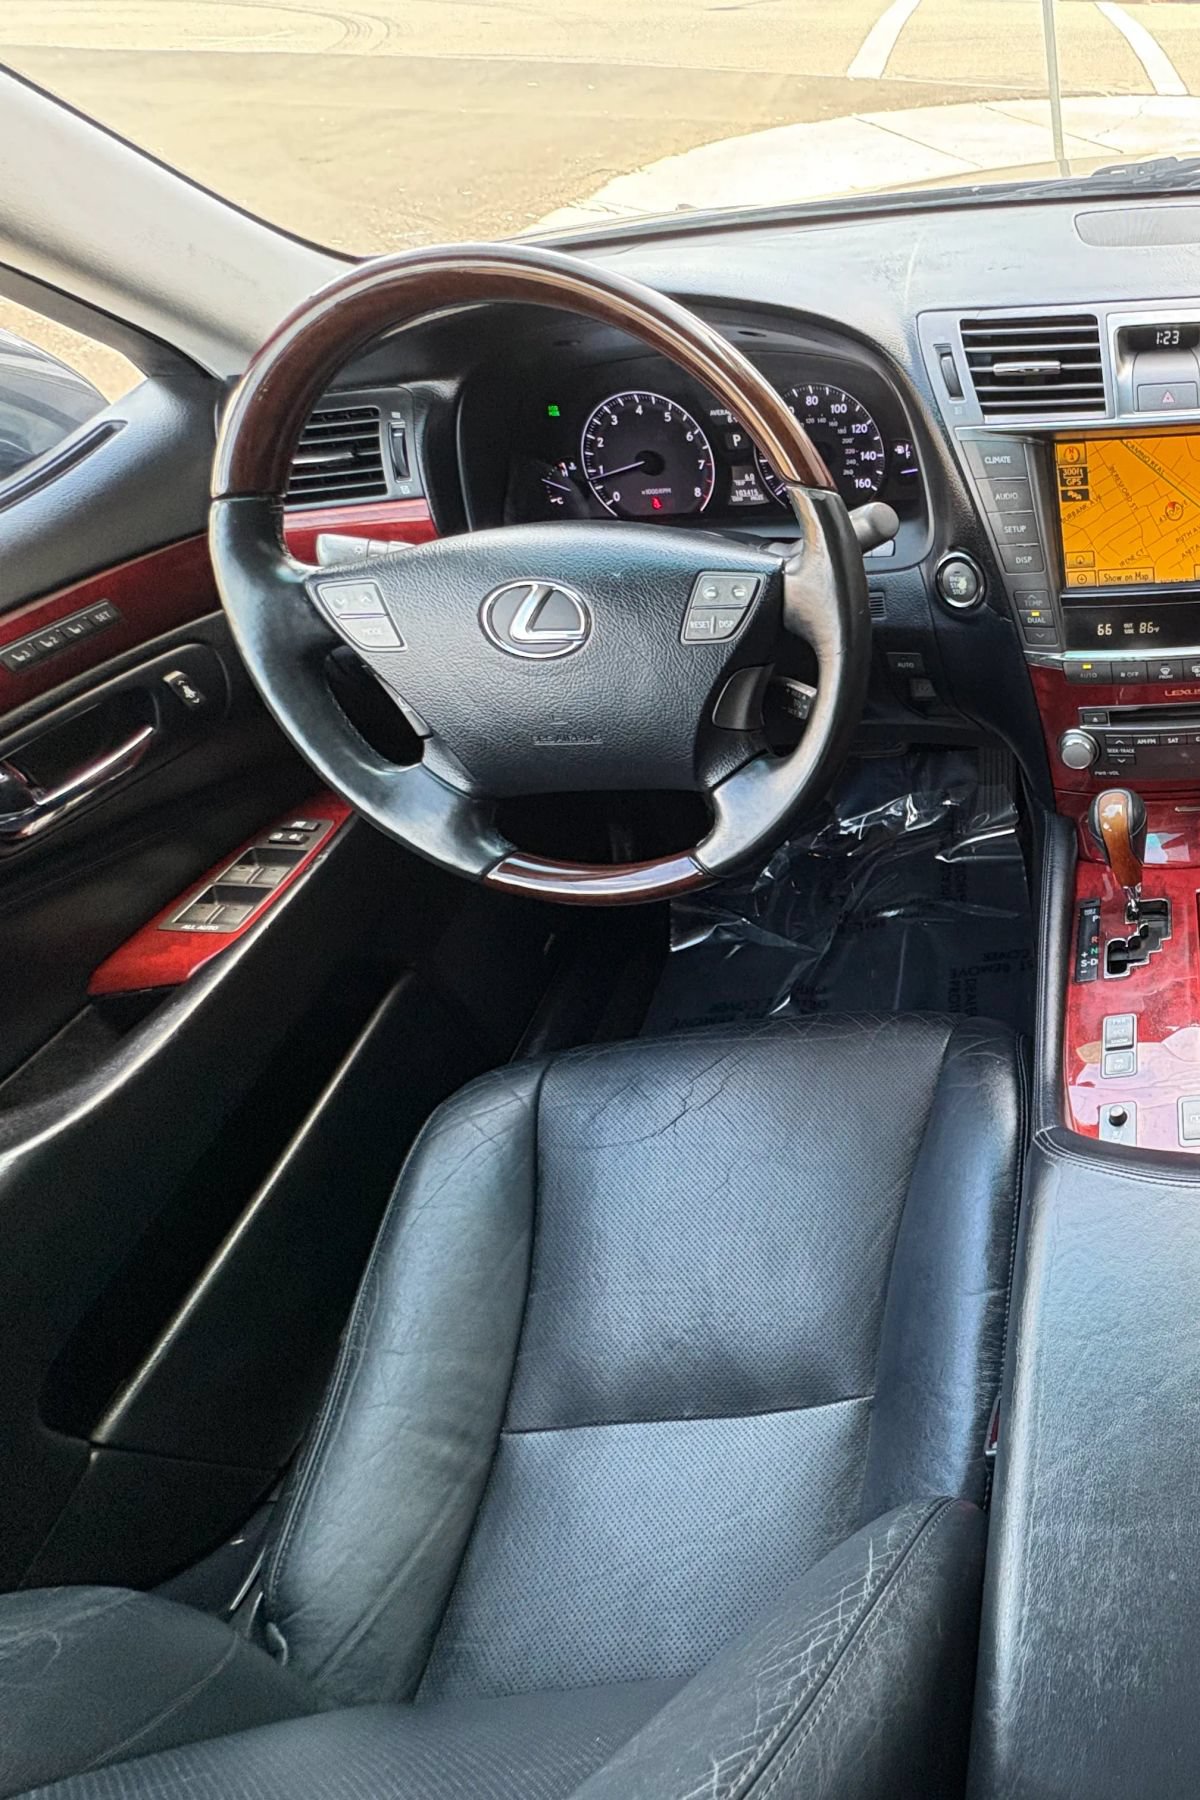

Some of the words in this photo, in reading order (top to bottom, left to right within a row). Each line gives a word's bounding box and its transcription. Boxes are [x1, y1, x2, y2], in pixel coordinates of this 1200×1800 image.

[1156, 330, 1179, 345] 1:23
[805, 395, 819, 406] 80
[635, 404, 643, 415] 4
[830, 403, 847, 414] 100
[611, 415, 618, 425] 3
[664, 412, 672, 422] 5
[852, 423, 868, 434] 120
[686, 431, 694, 442] 6
[732, 434, 741, 447] P
[597, 437, 604, 448] 2
[860, 450, 877, 461] 140
[985, 456, 1011, 464] CLIMATE
[698, 460, 705, 470] 7
[855, 478, 872, 489] 160
[1066, 478, 1081, 486] GPS
[612, 491, 621, 502] 0
[694, 487, 702, 497] 8
[995, 492, 1018, 501] AUDIO
[1004, 525, 1026, 534] SETUP
[1015, 556, 1033, 564] DISP
[1104, 573, 1122, 582] Show
[1135, 571, 1149, 581] Map
[94, 611, 111, 622] SET
[690, 620, 710, 629] RESET
[718, 620, 734, 629] DISP
[1097, 623, 1112, 636] 66
[1092, 914, 1099, 923] P
[1091, 936, 1098, 944] R
[1090, 947, 1099, 955] N
